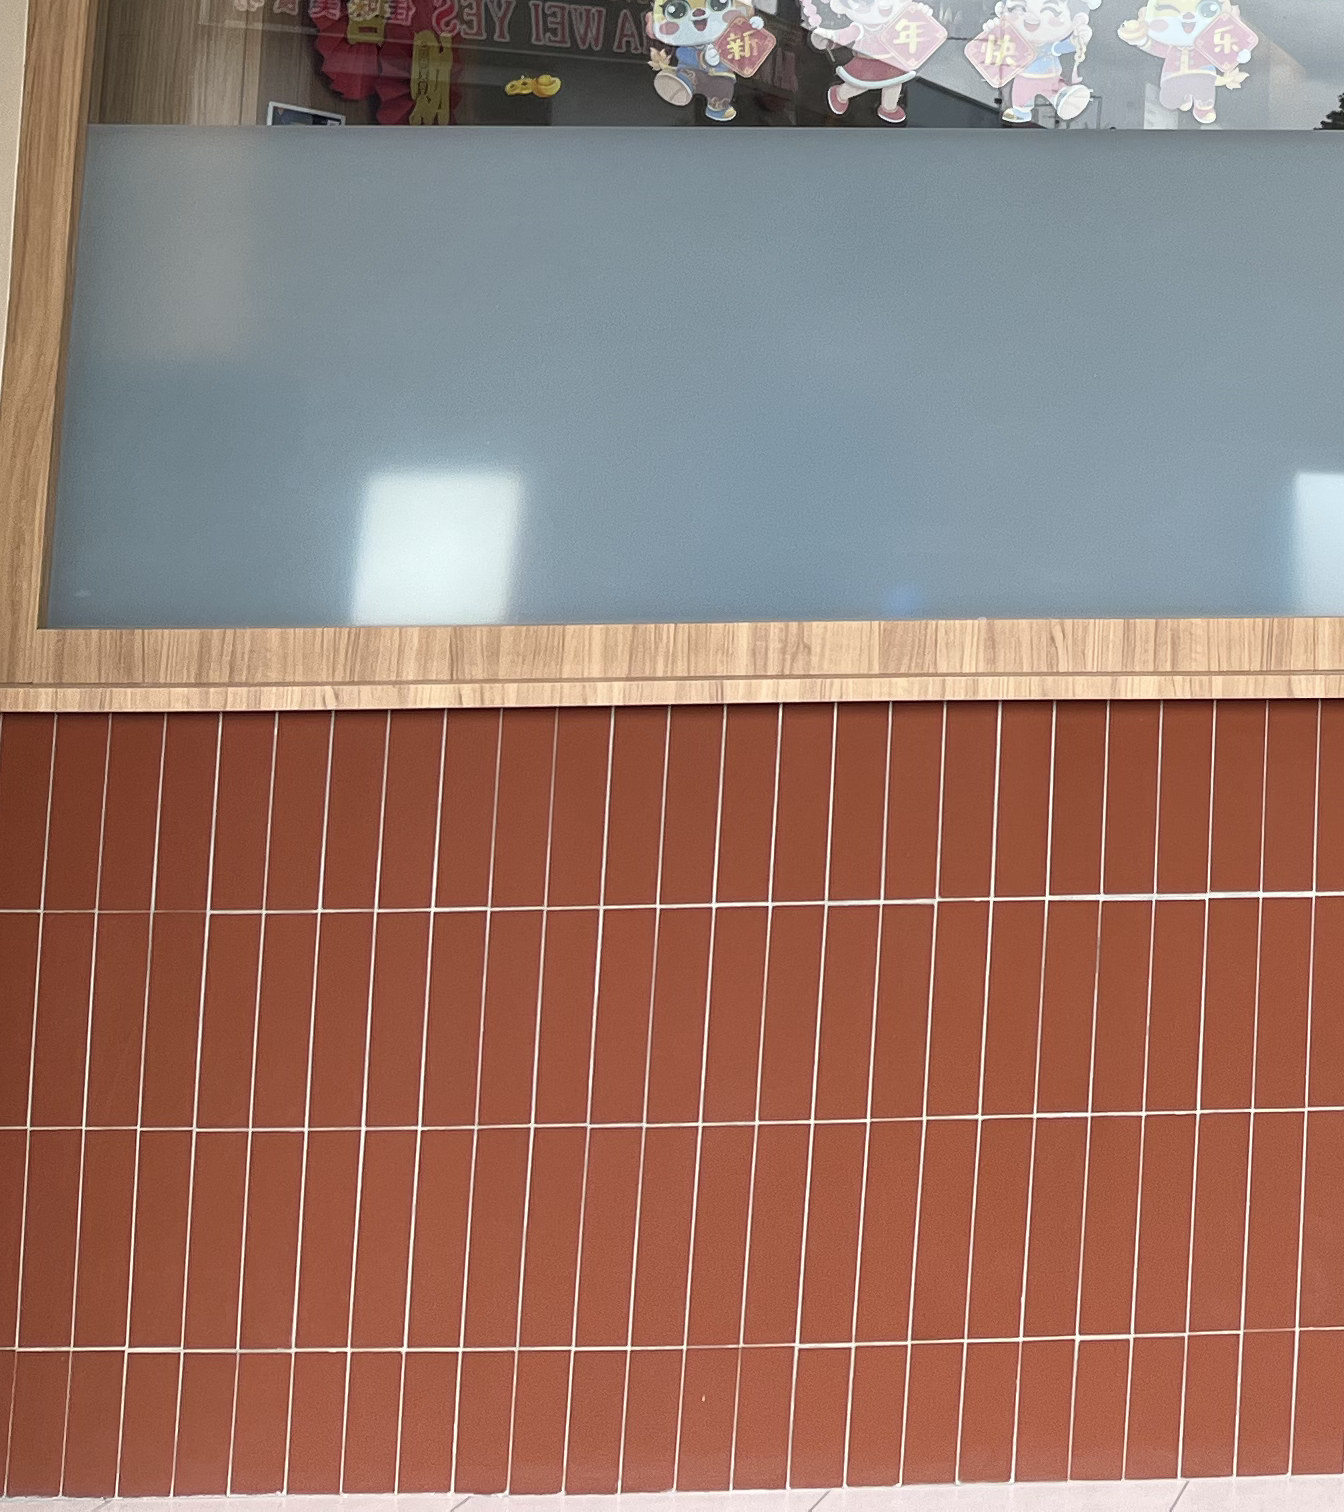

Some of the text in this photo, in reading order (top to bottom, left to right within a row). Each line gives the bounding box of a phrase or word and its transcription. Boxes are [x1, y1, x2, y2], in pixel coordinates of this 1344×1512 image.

[726, 19, 1240, 68] 新 年 快 乐
